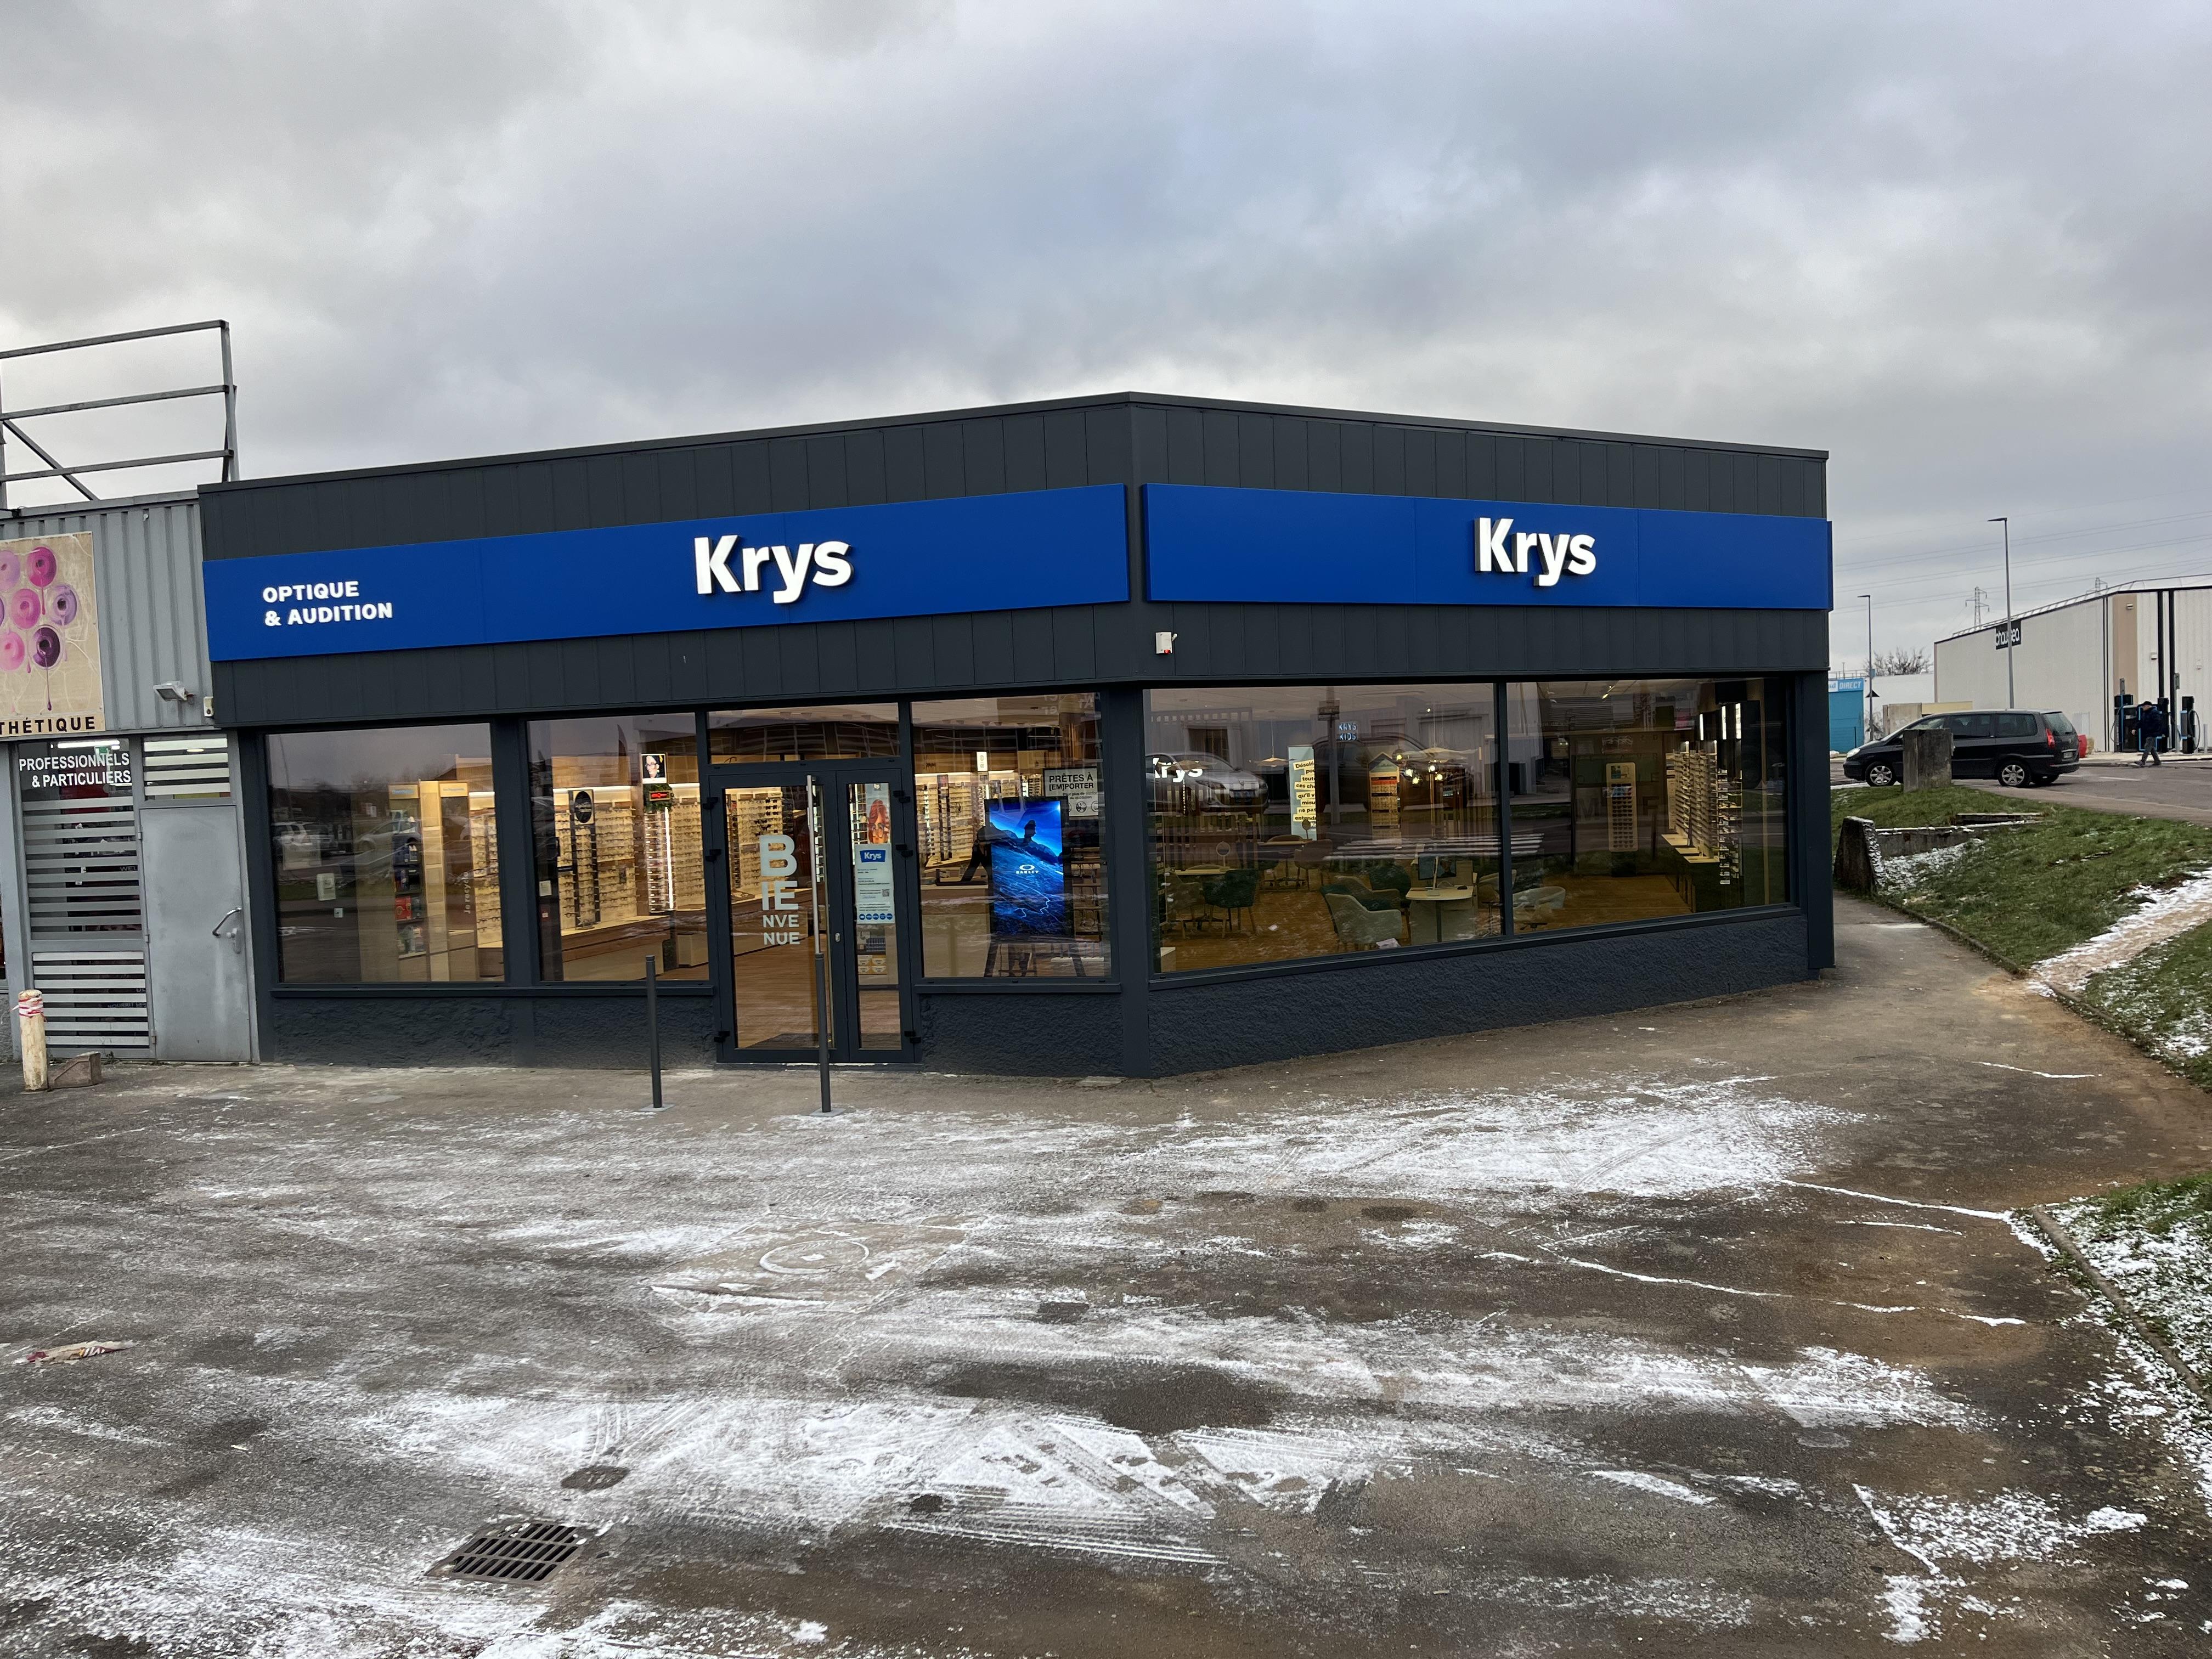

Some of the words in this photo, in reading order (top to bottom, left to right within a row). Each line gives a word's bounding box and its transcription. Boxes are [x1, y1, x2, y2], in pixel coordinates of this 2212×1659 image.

[1474, 517, 1596, 586] Krys
[695, 534, 853, 604] Krys
[262, 580, 360, 603] OPTIQUE
[264, 611, 282, 627] &
[287, 602, 393, 625] AUDITION
[1839, 681, 1861, 690] DIRECT
[19, 753, 130, 771] PROFESSIONNELS
[32, 775, 41, 788] &
[43, 770, 131, 787] PARTICULIERS
[1049, 772, 1085, 783] PRÊTES
[1087, 772, 1093, 781] À
[1049, 782, 1094, 792] [EM]PORTER
[864, 851, 882, 860] Krys
